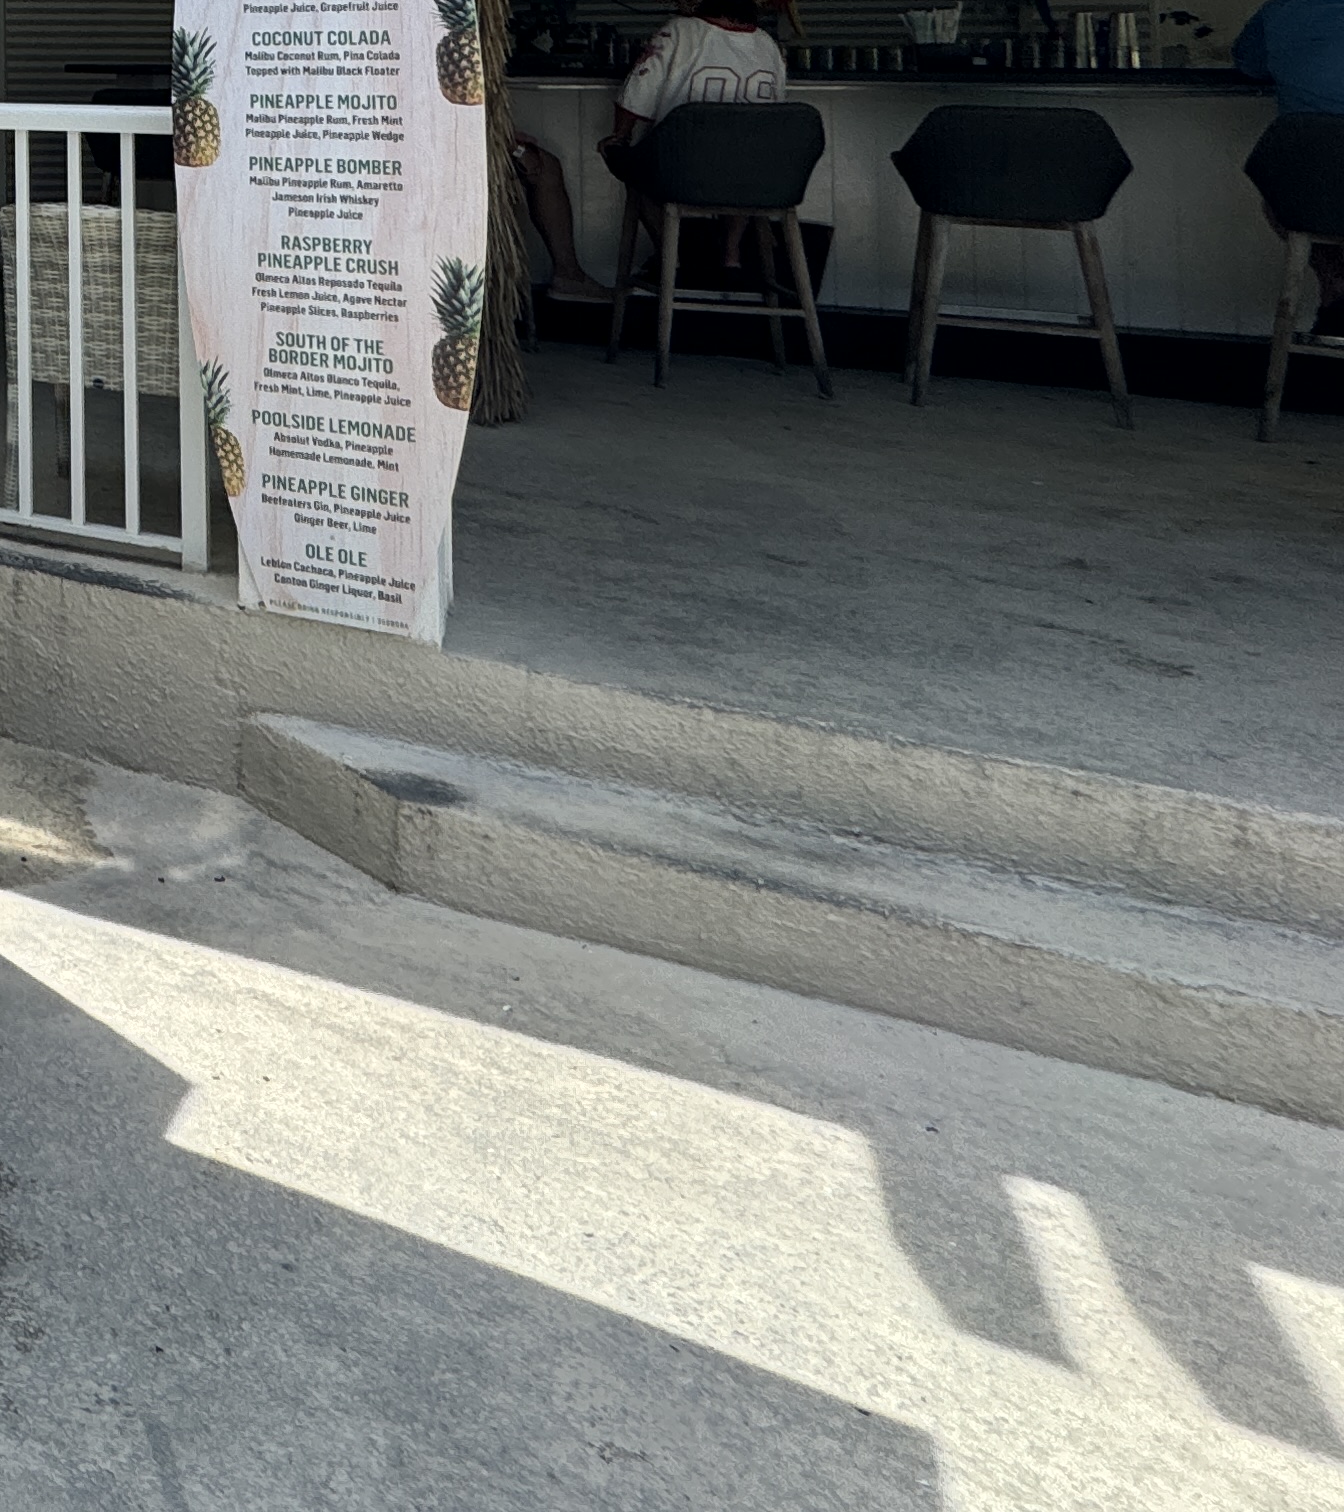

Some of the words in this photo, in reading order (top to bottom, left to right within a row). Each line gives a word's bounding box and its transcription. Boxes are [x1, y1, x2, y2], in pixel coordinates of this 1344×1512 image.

[243, 4, 288, 14] Pineapple
[290, 3, 319, 13] Juice,
[321, 2, 369, 12] Grapefruit
[372, 1, 399, 11] Juice
[252, 31, 323, 46] COCONUT
[327, 30, 391, 45] COLADA
[245, 51, 275, 61] Malibu
[277, 51, 315, 60] Coconut
[367, 50, 400, 60] Colada
[245, 67, 278, 77] Topped
[281, 66, 300, 75] with
[303, 67, 334, 76] Malibu
[336, 66, 363, 75] Black
[365, 66, 400, 75] Floater
[250, 94, 334, 109] PINEAPPLE
[337, 95, 397, 110] MOJITO
[246, 114, 277, 124] Malibu
[278, 114, 324, 125] Pineapple
[353, 116, 379, 125] Fresh
[381, 116, 403, 126] Mint
[245, 129, 290, 140] Pineapple
[323, 130, 369, 141] Pineapple
[372, 131, 404, 142] Wedge
[249, 156, 333, 173] PINEAPPLE
[337, 159, 402, 176] BOMBER
[250, 176, 280, 186] Malibu
[282, 177, 327, 189] Pineapple
[357, 180, 403, 191] Amaretto
[272, 192, 314, 203] Jameson
[316, 193, 337, 204] Irish
[340, 195, 379, 207] Whiskey
[288, 207, 334, 220] Pineapple
[336, 210, 363, 220] Juice
[281, 235, 372, 255] RASPBERRY
[258, 253, 342, 272] PINEAPPLE
[346, 258, 399, 276] CRUSH
[318, 277, 364, 289] Reposado
[367, 280, 402, 292] Tequila
[252, 287, 277, 298] Fresh
[279, 288, 310, 300] Lemon
[343, 293, 372, 306] Agave
[374, 296, 407, 307] Nectar
[260, 302, 306, 316] Pineapple
[341, 308, 399, 323] Raspberries
[276, 332, 326, 351] SOUTH
[331, 336, 350, 352] OF
[353, 338, 384, 355] THE
[269, 348, 328, 368] BORDER
[333, 355, 393, 374] MOJITO
[327, 373, 359, 386] Blanco
[254, 381, 279, 393] Fresh
[334, 389, 382, 404] Pineapple
[385, 395, 411, 407] Juice
[251, 409, 325, 432] POOLSIDE
[329, 418, 416, 443] LEMONADE
[274, 432, 309, 445] Absolut
[345, 440, 393, 456] Pineapple
[269, 446, 321, 461] Homemade
[377, 460, 399, 472] Mint
[262, 474, 346, 499] PINEAPPLE
[351, 485, 409, 508] GINGER
[294, 513, 324, 527] Ginger
[353, 522, 377, 534] Lime
[334, 503, 381, 520] Pineapple
[383, 511, 411, 524] Juice
[306, 543, 335, 562] OLE
[338, 549, 367, 567] OLE
[338, 569, 386, 586] Pineapple
[389, 578, 416, 591] Juice
[309, 579, 340, 594] Ginger
[378, 591, 402, 604] Basil
